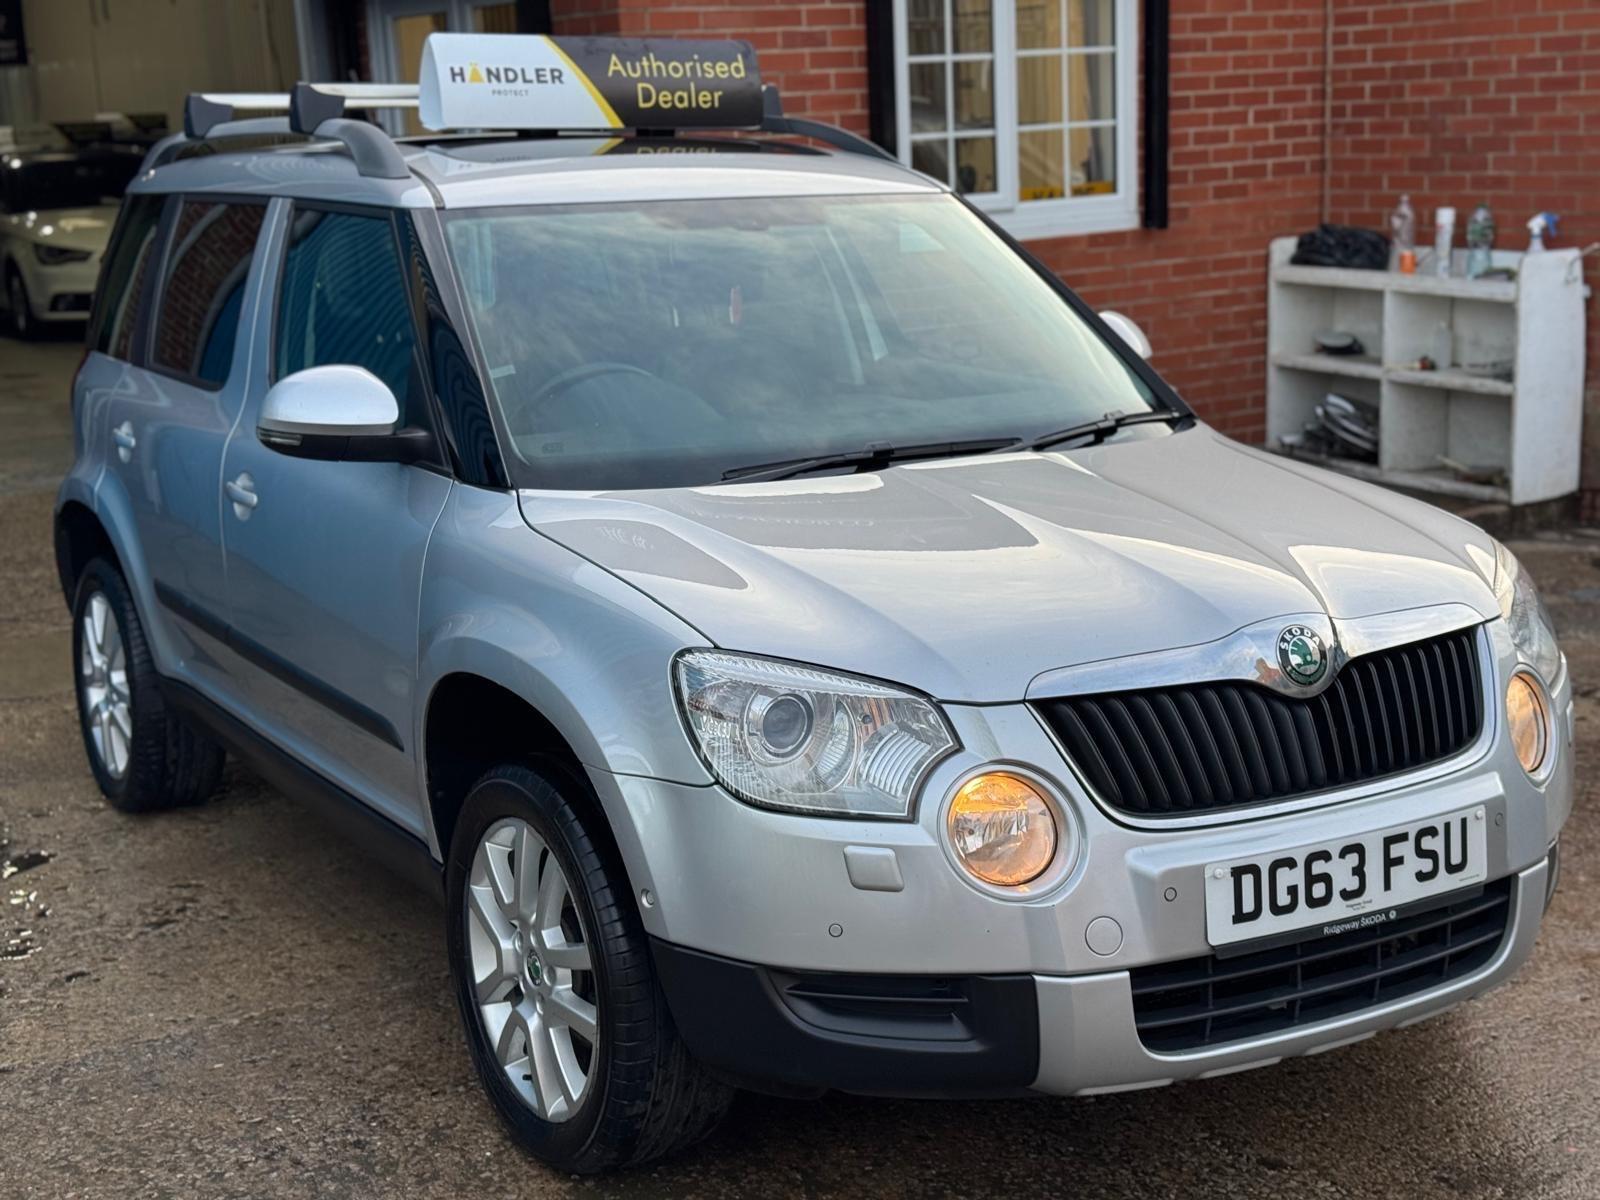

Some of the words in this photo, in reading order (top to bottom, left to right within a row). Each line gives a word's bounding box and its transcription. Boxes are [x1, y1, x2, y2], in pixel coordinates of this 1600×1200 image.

[607, 52, 746, 78] Authorised
[491, 89, 529, 97] PROTECT
[636, 81, 723, 109] Dealer
[1230, 842, 1367, 925] DG63
[1383, 817, 1468, 892] FSU
[1323, 920, 1360, 936] Ridgeway
